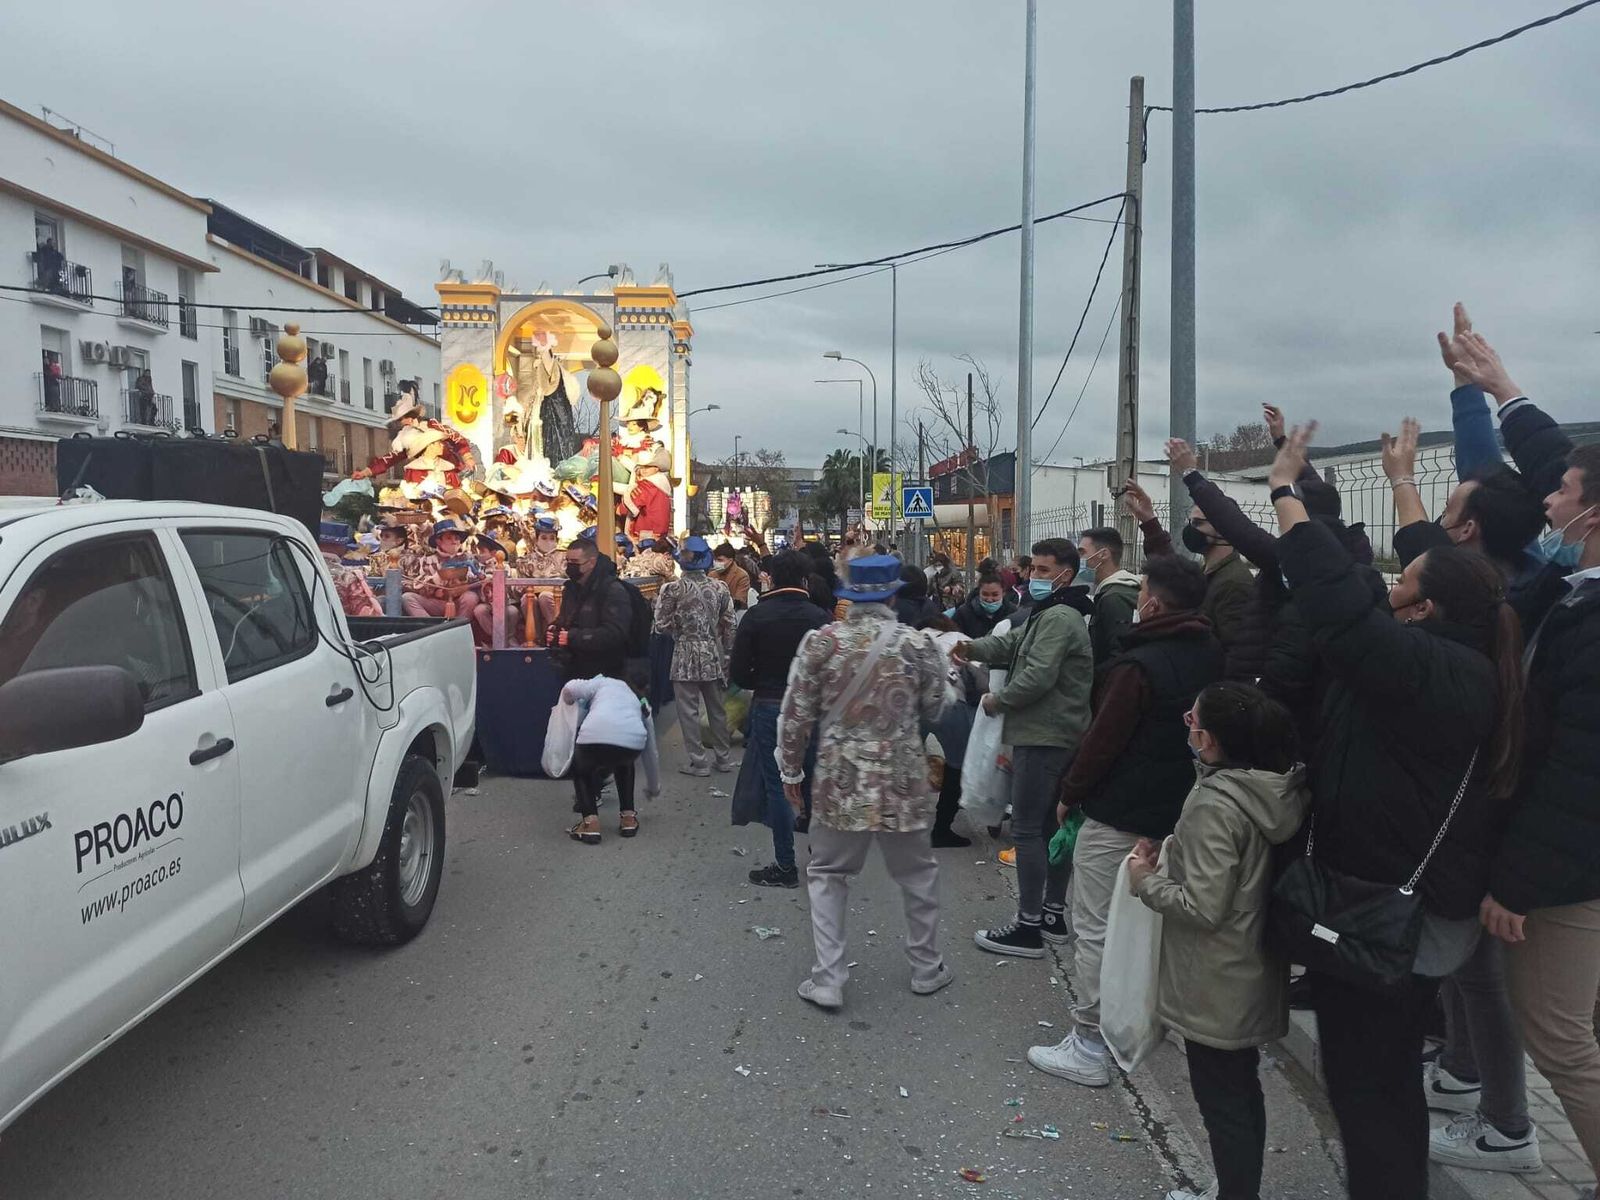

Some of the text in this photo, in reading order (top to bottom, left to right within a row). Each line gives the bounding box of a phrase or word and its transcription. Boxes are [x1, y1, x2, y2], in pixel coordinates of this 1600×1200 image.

[0, 811, 52, 849] ILUX
[74, 793, 183, 873] PROACO
[81, 857, 181, 925] www.proaco.es
